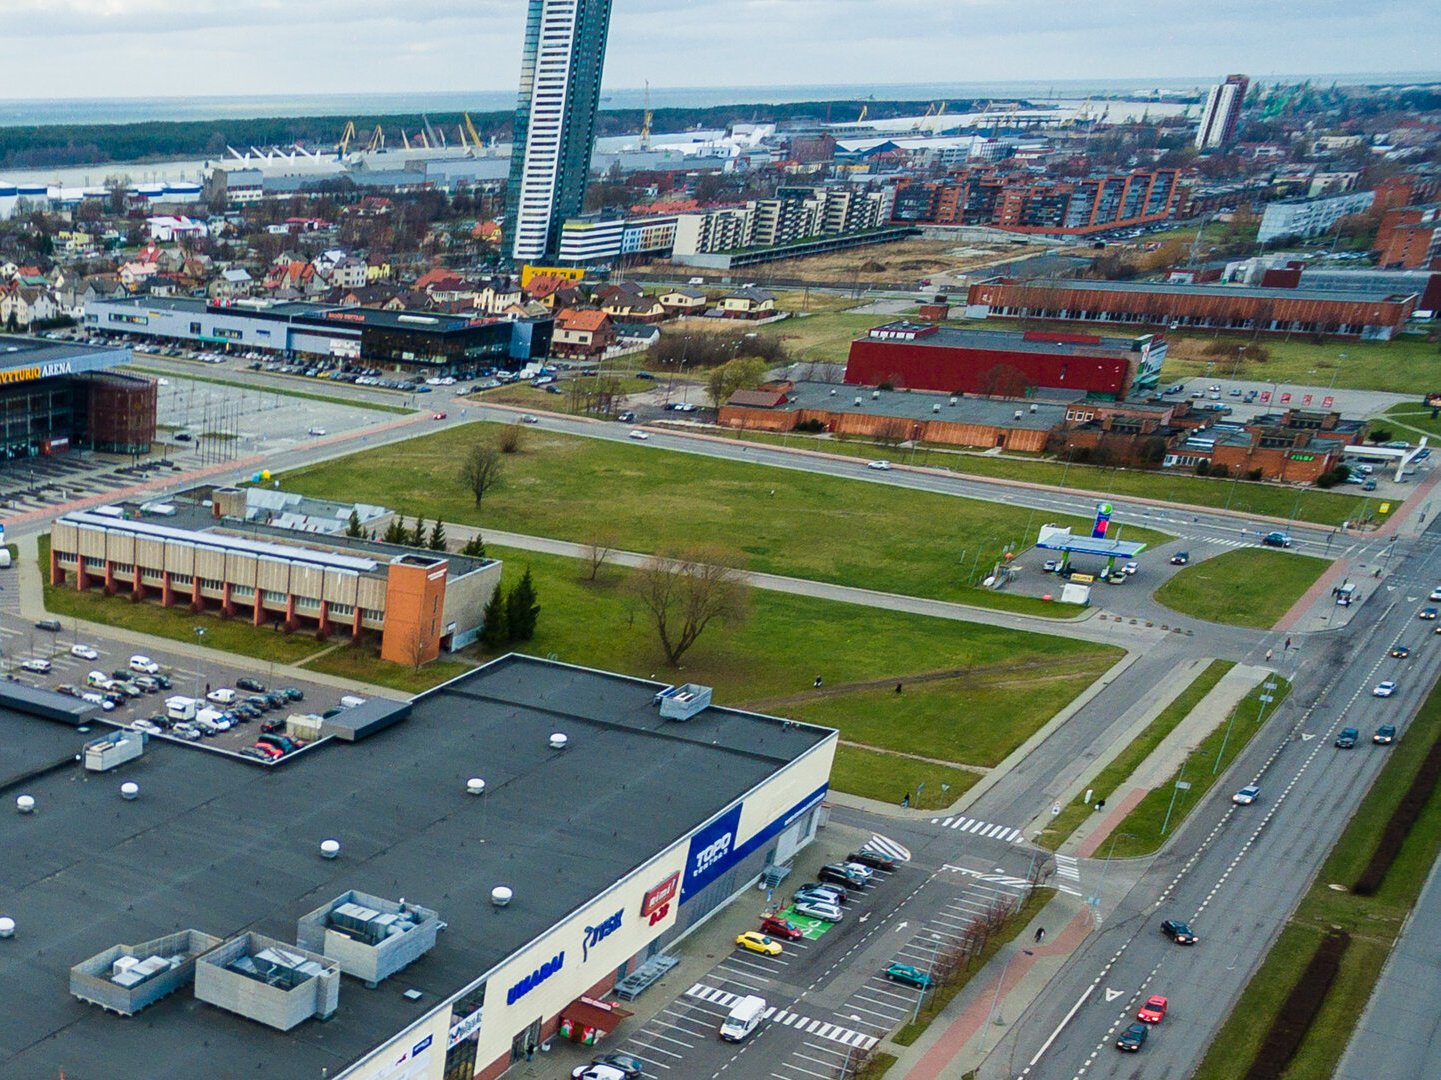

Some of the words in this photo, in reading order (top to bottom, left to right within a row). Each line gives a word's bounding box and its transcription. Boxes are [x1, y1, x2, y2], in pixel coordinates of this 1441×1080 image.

[41, 361, 72, 377] ARENA
[696, 832, 732, 868] TOPO
[588, 907, 625, 949] JYSK
